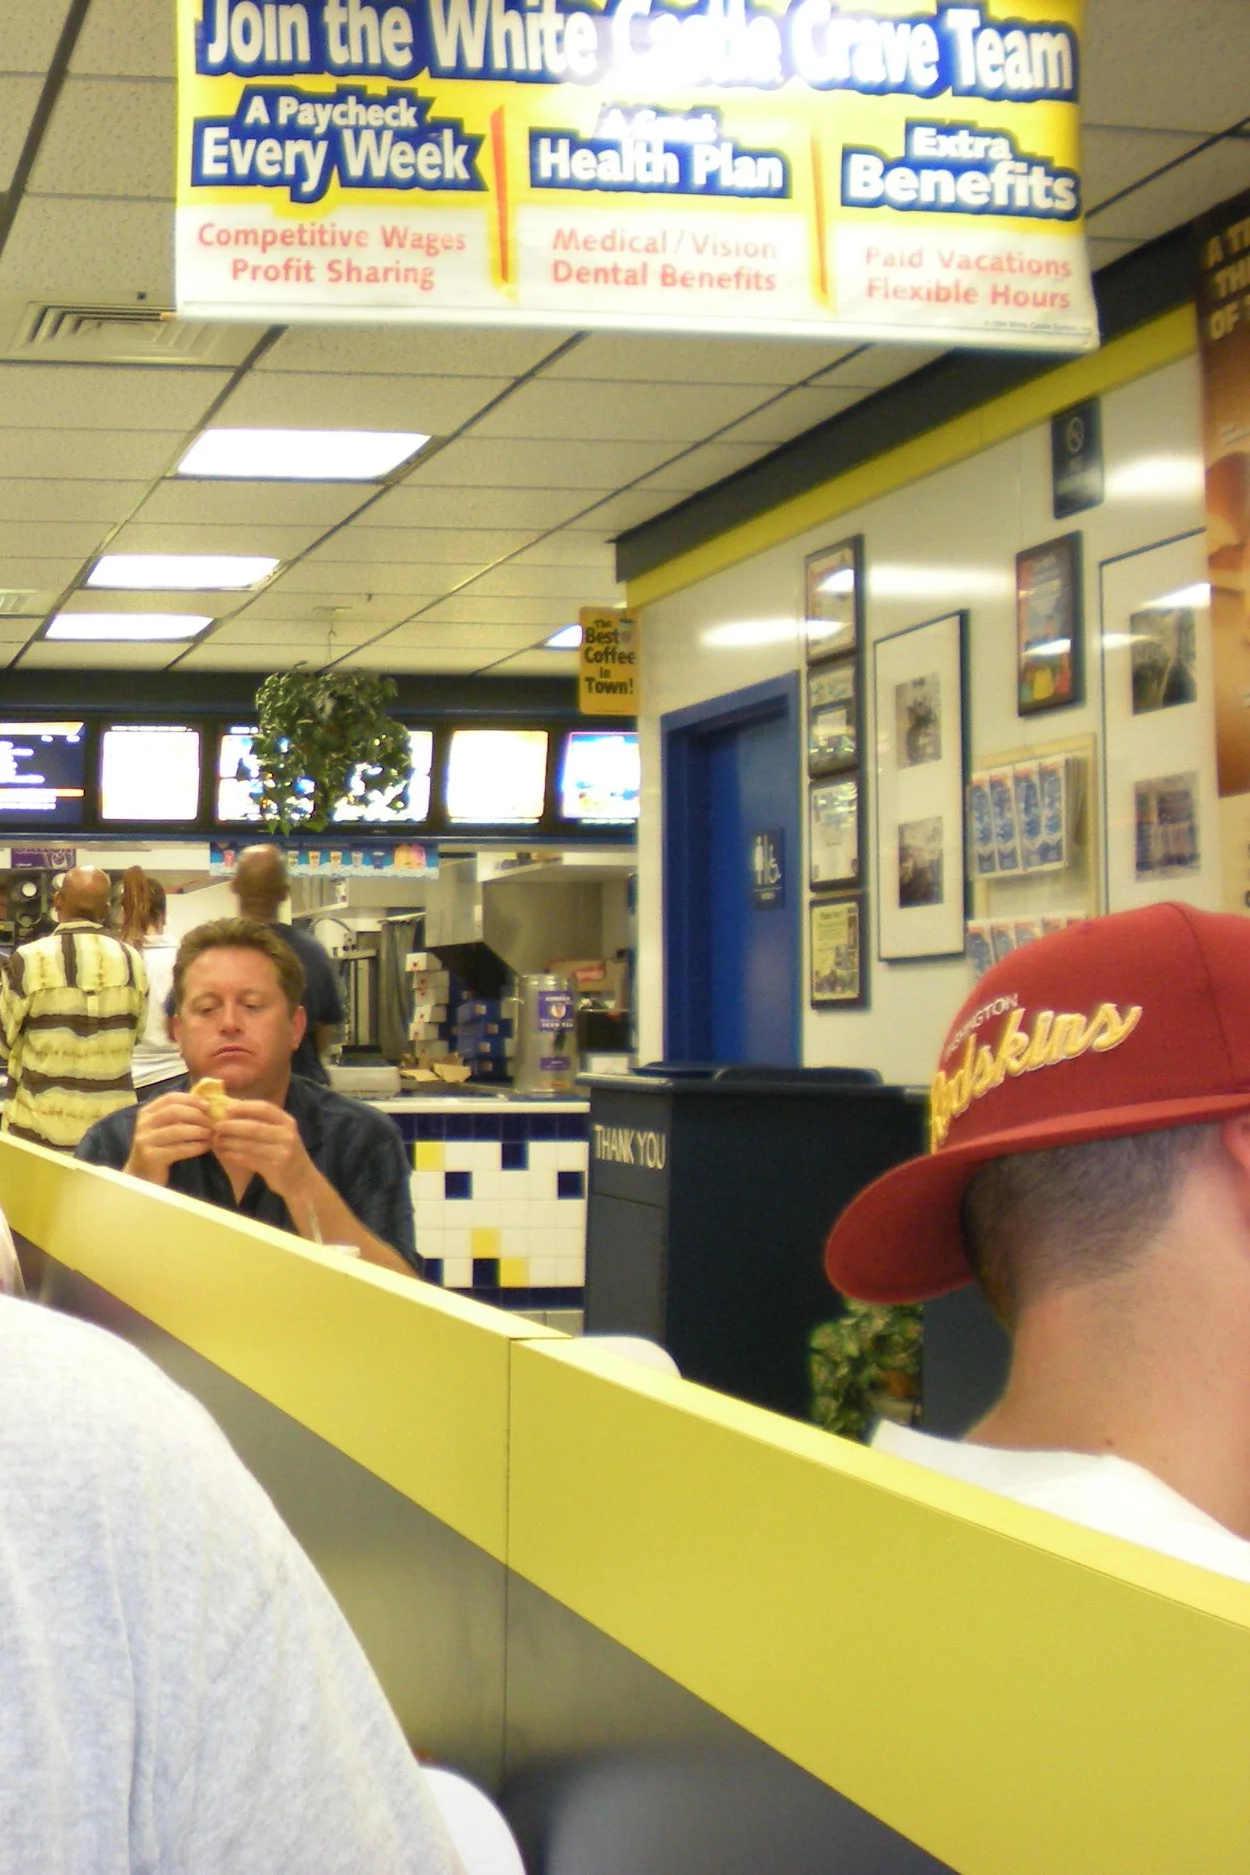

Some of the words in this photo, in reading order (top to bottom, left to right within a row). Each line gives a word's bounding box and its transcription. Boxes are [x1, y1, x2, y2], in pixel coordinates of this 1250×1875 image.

[208, 0, 310, 63] Join
[325, 0, 413, 67] the
[430, 0, 597, 75] White
[792, 0, 939, 86] Crave
[947, 9, 1072, 90] Team
[245, 96, 268, 124] A
[279, 96, 418, 134] Paycheck
[202, 126, 328, 192] Every
[342, 129, 470, 181] Week
[912, 126, 1011, 160] Extra
[539, 137, 680, 184] Health
[693, 142, 783, 188] Plan
[849, 152, 1076, 210] Benefits
[197, 222, 368, 253] Competitive
[381, 225, 466, 257] Wages
[231, 258, 315, 283] Profit
[327, 259, 435, 291] Sharing
[552, 259, 649, 286] Dental
[660, 264, 777, 291] Benefits
[865, 246, 924, 268] Paid
[937, 249, 1073, 277] Vacations
[866, 276, 979, 304] Flexible
[990, 282, 1071, 309] Hours
[584, 627, 620, 644] Best
[584, 646, 636, 665] Coffee
[584, 677, 634, 695] Town!
[594, 1124, 634, 1165] THANK
[637, 1131, 666, 1169] YOU
